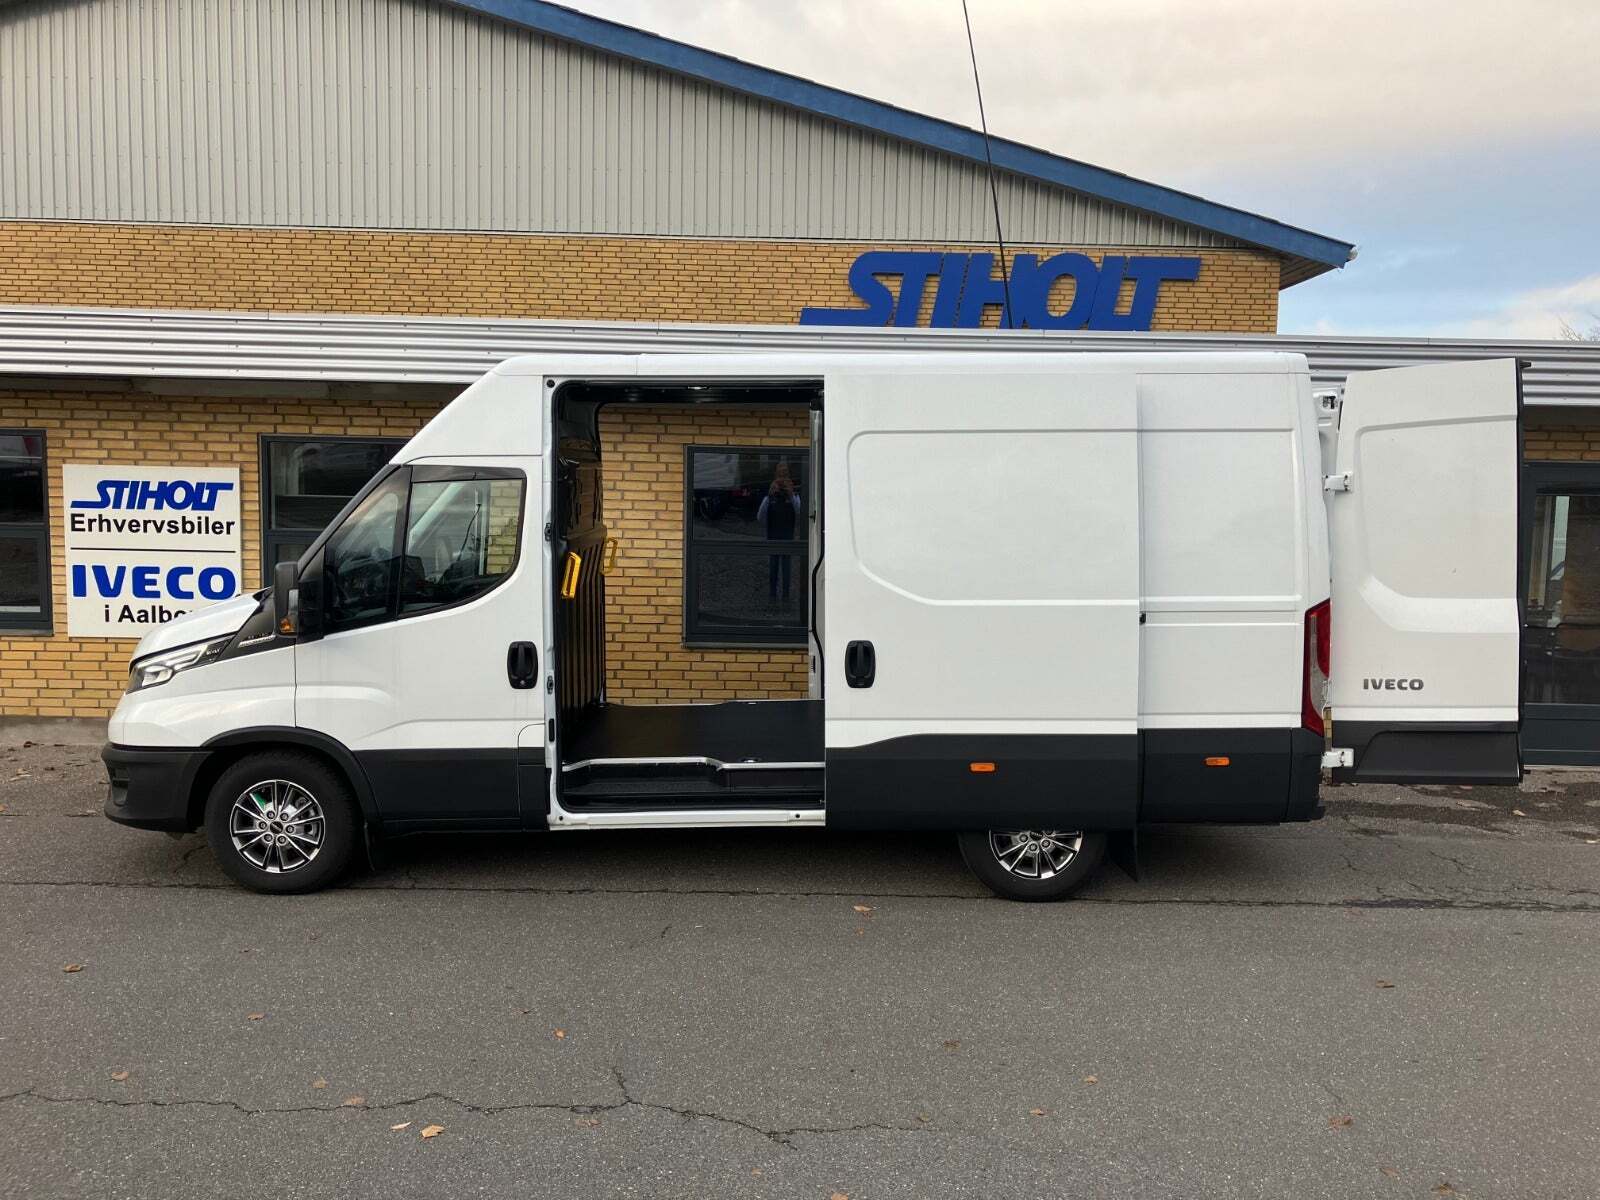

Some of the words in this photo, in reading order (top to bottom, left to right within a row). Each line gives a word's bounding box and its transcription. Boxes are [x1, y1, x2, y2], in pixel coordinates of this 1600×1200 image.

[800, 251, 1201, 331] STIHOLT
[70, 480, 234, 511] STIHOLT
[70, 513, 235, 535] Erhvervsbiler
[72, 564, 236, 600] IVECO
[104, 604, 110, 623] i
[1362, 678, 1425, 691] IVECO
